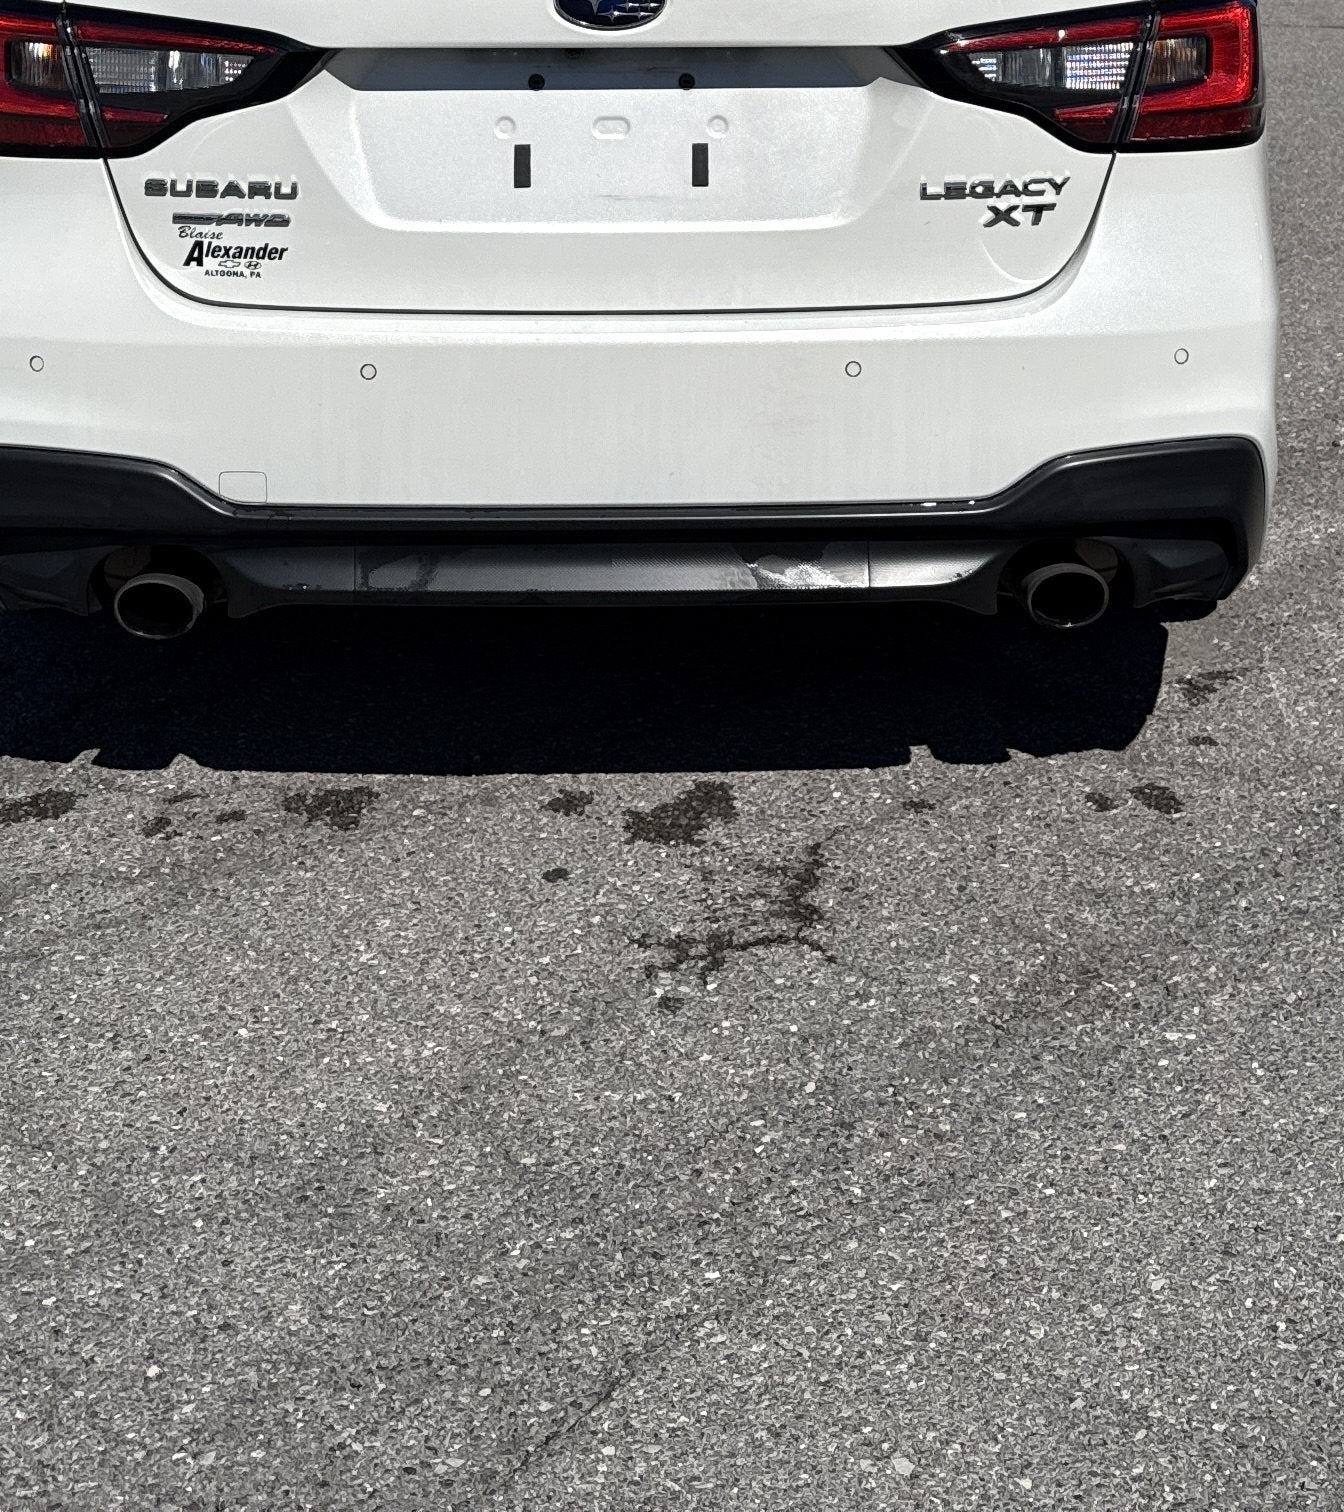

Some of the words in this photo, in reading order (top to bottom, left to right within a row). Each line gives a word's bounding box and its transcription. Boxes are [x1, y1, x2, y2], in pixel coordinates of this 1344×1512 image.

[144, 178, 299, 200] SUBARU
[919, 176, 1072, 201] LEGACY
[214, 212, 292, 228] AWD
[982, 203, 1057, 228] XT
[177, 225, 224, 241] Blaise
[182, 239, 289, 268] Alexander
[249, 270, 262, 279] PA
